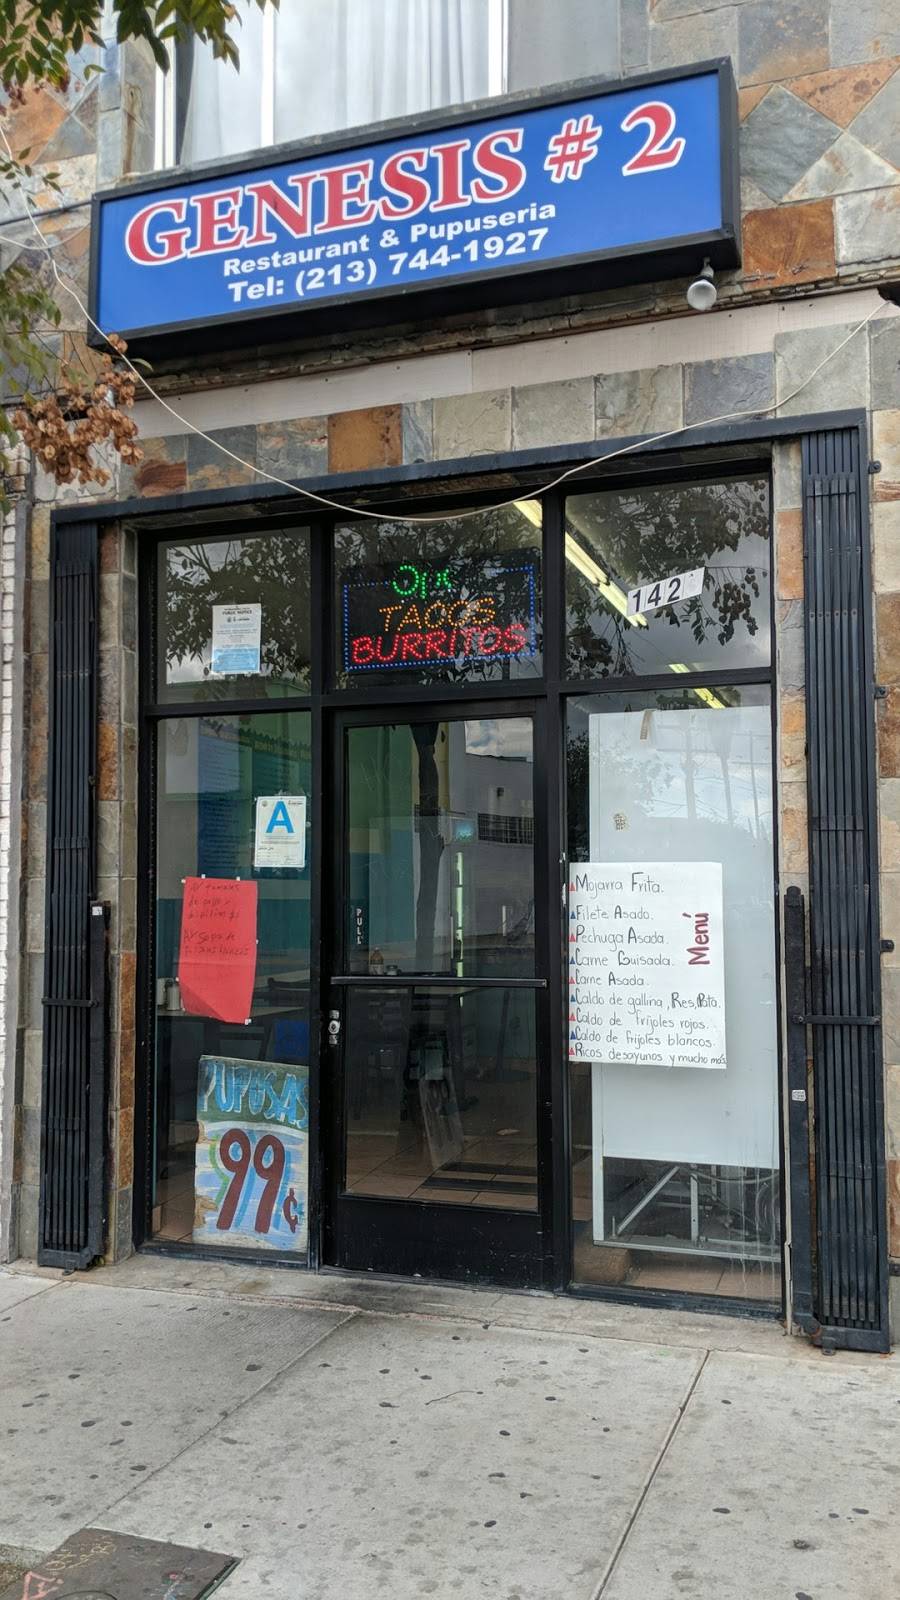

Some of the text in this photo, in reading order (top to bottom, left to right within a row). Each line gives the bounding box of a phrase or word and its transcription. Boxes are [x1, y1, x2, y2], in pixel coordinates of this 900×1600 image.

[125, 101, 686, 266] GENESIS # 2
[223, 203, 556, 277] Restaurant & Pupuseria
[228, 228, 549, 303] Tel: (213) 744-1927
[632, 576, 682, 613] 142
[379, 597, 496, 632] TACOS
[352, 623, 527, 664] BURRITOS
[266, 800, 295, 834] A
[575, 871, 665, 899] Mojarra Frita.
[355, 907, 364, 946] PULL
[576, 904, 609, 920] Filete
[575, 924, 623, 952] Pechuga
[682, 912, 711, 965] Menú
[575, 947, 609, 966] Carne
[575, 968, 602, 985] Carne
[575, 987, 605, 1005] Caldo
[609, 991, 624, 1006] de
[575, 1007, 603, 1026] Caldo
[609, 1011, 623, 1026] de
[575, 1025, 602, 1042] Caldo
[605, 1029, 619, 1044] de
[574, 1041, 603, 1058] Ricos
[669, 1053, 676, 1068] y
[677, 1052, 709, 1065] mucho
